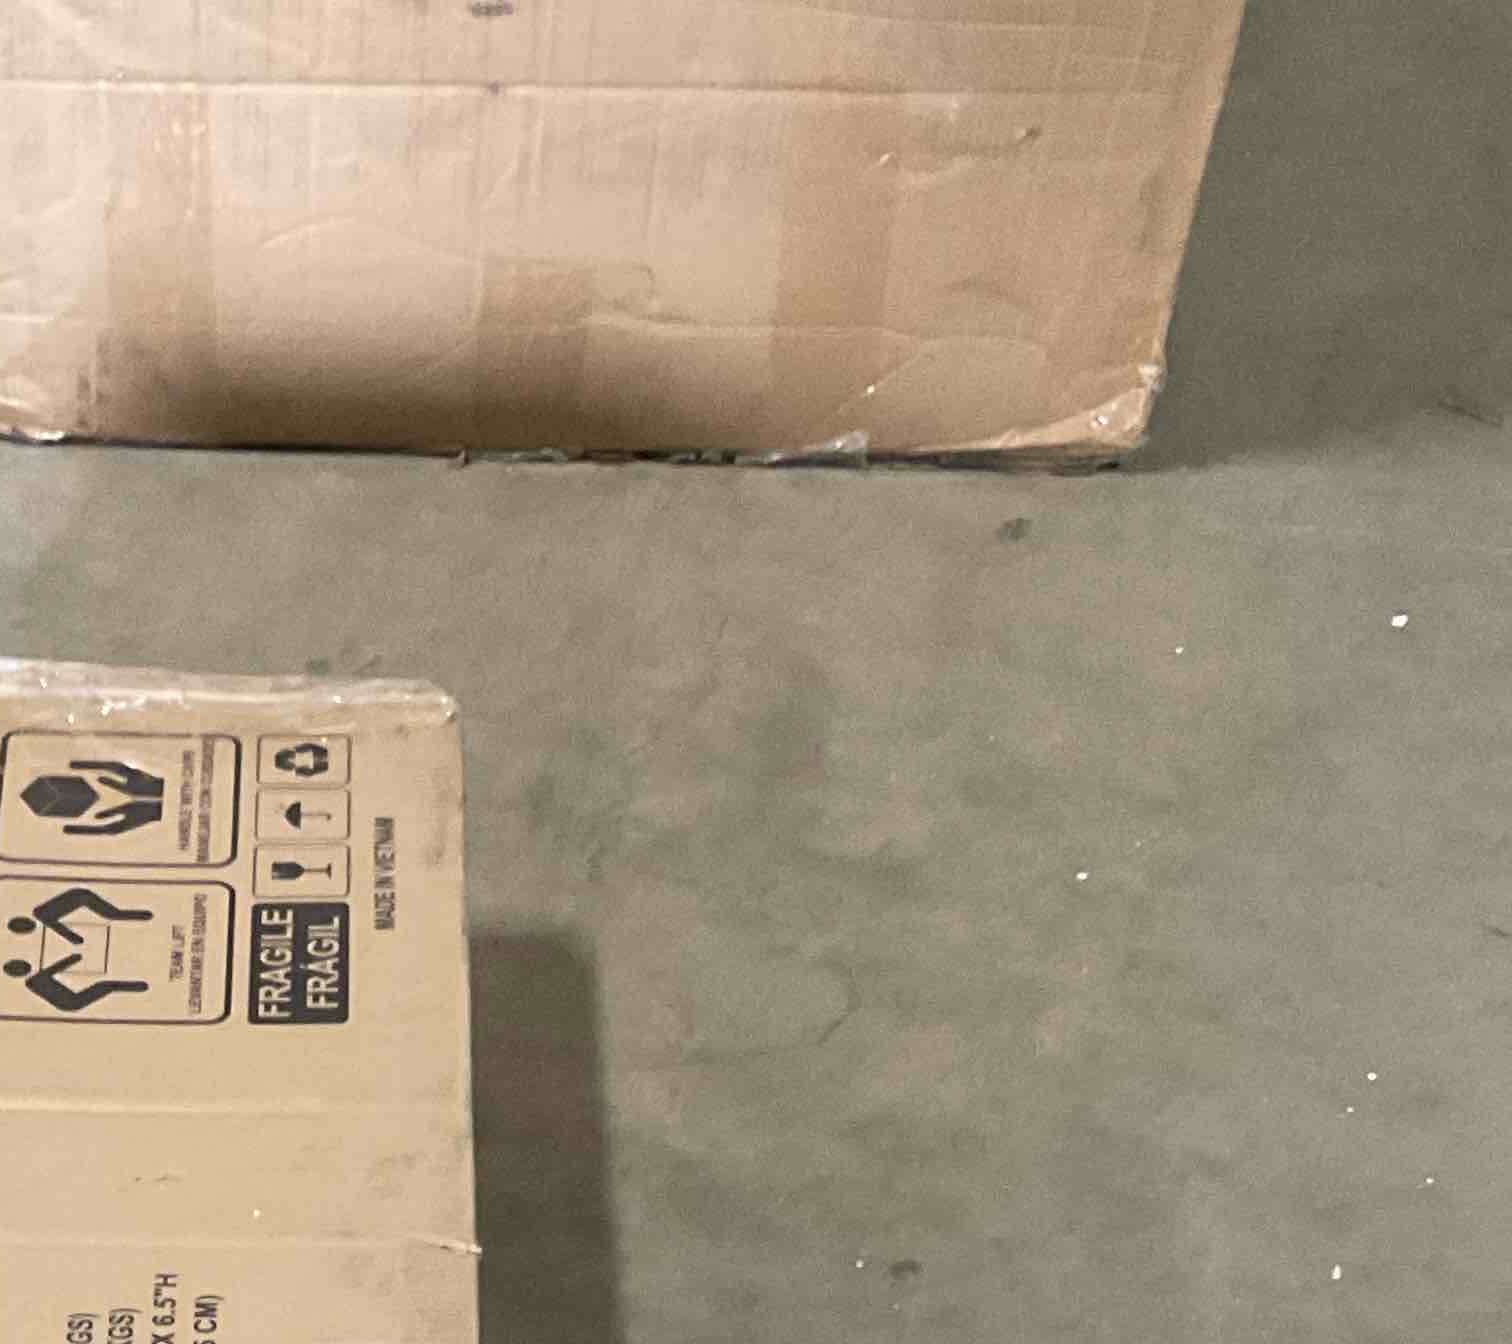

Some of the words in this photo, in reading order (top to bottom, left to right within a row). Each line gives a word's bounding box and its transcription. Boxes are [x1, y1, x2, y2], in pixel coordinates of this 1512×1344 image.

[374, 818, 396, 876] VIETNAM
[374, 877, 395, 889] IN
[374, 892, 395, 930] MADE
[257, 909, 293, 1018] FRAGILE
[300, 916, 339, 1009] FRÁGIL
[152, 1273, 180, 1327] 6.5"H
[193, 1295, 225, 1334] CM)
[151, 1333, 175, 1344] X
